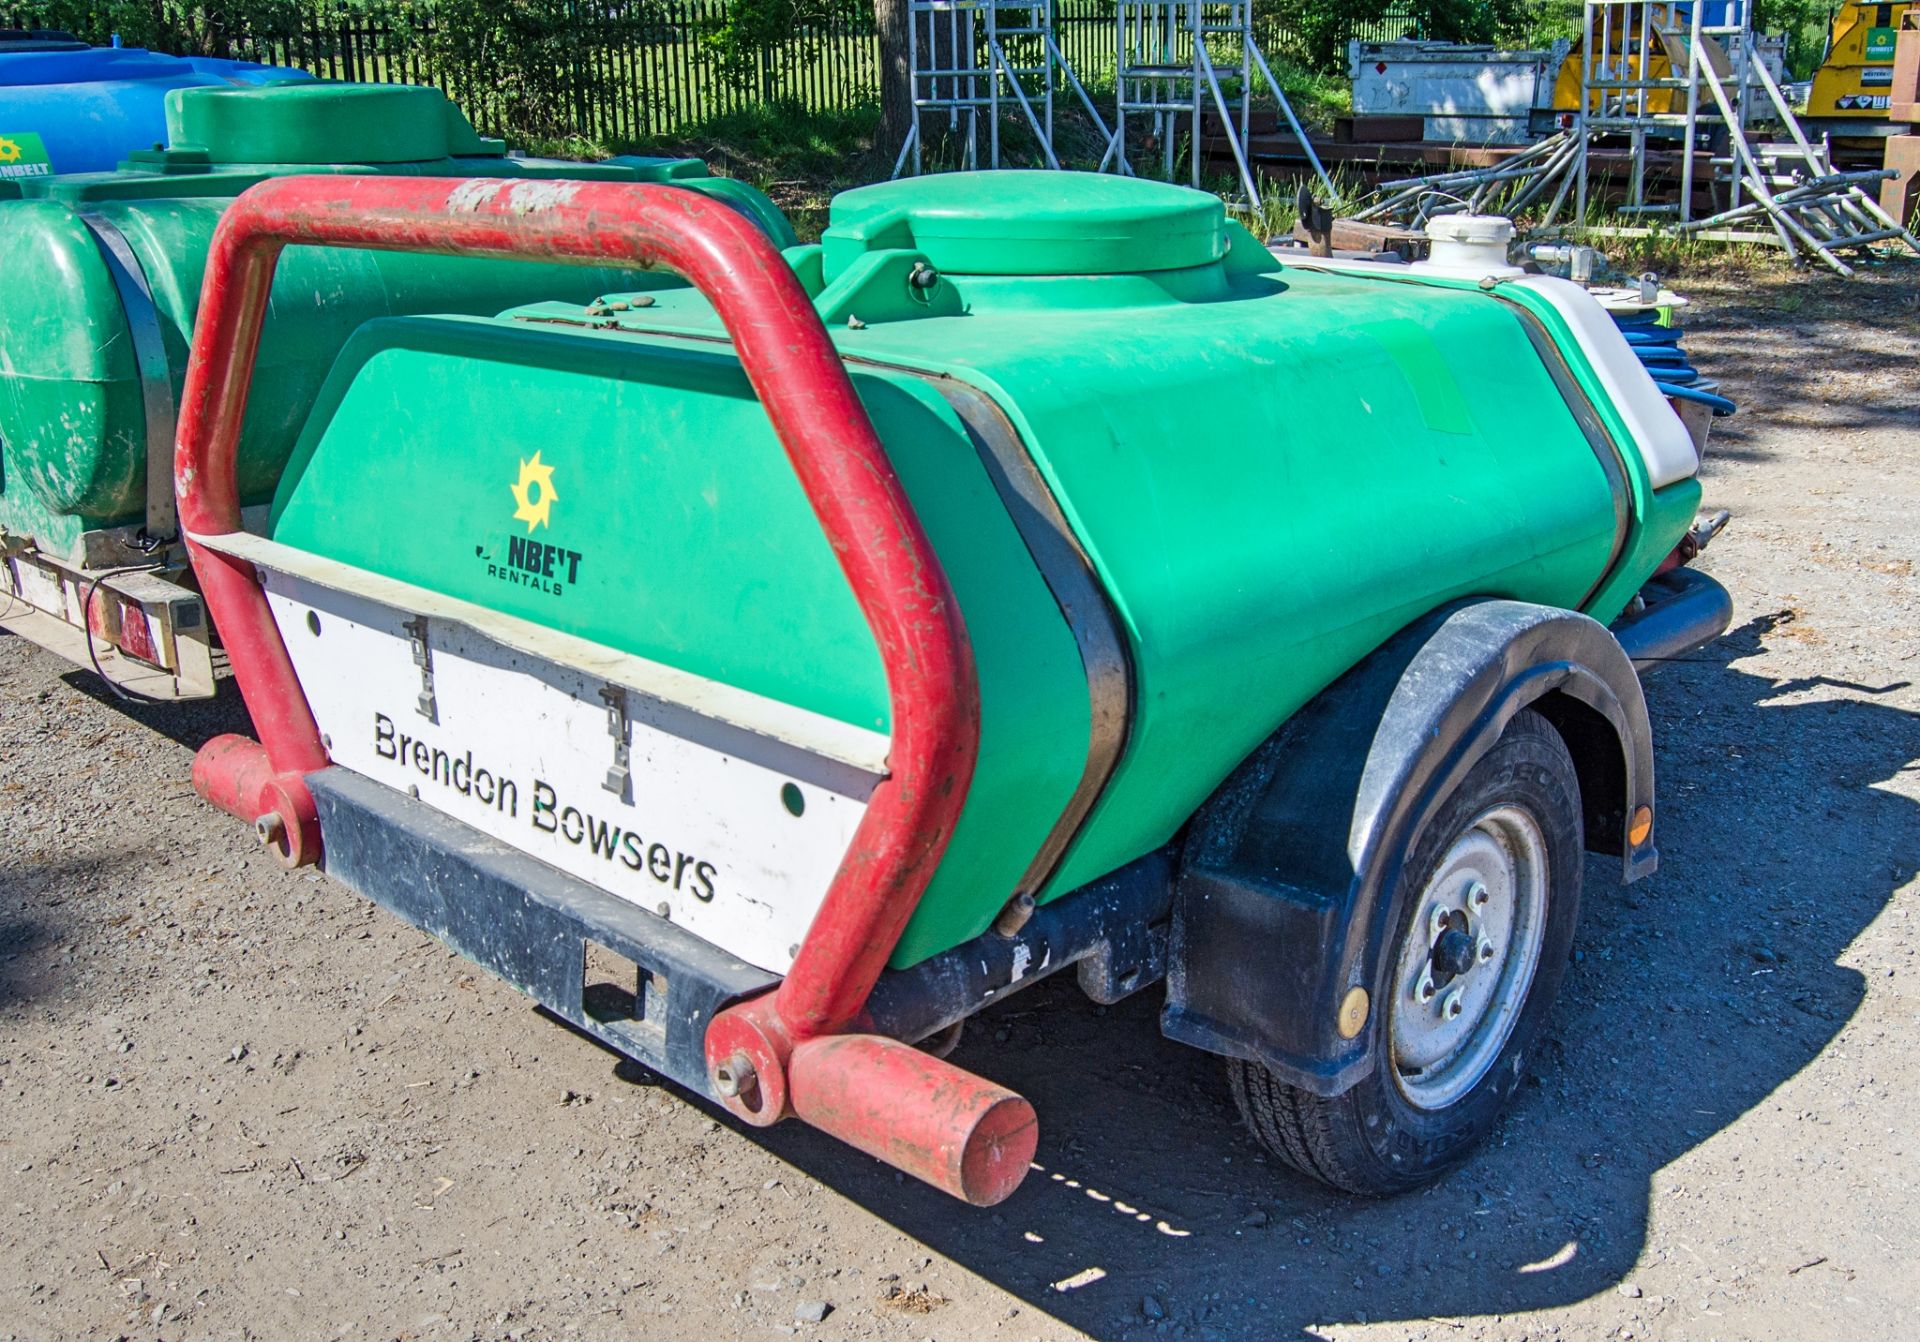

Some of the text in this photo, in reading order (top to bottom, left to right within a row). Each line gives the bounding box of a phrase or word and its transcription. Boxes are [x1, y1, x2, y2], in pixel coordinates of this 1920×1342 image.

[487, 563, 563, 597] RENTALS
[374, 711, 720, 904] Brendon Bowsers
